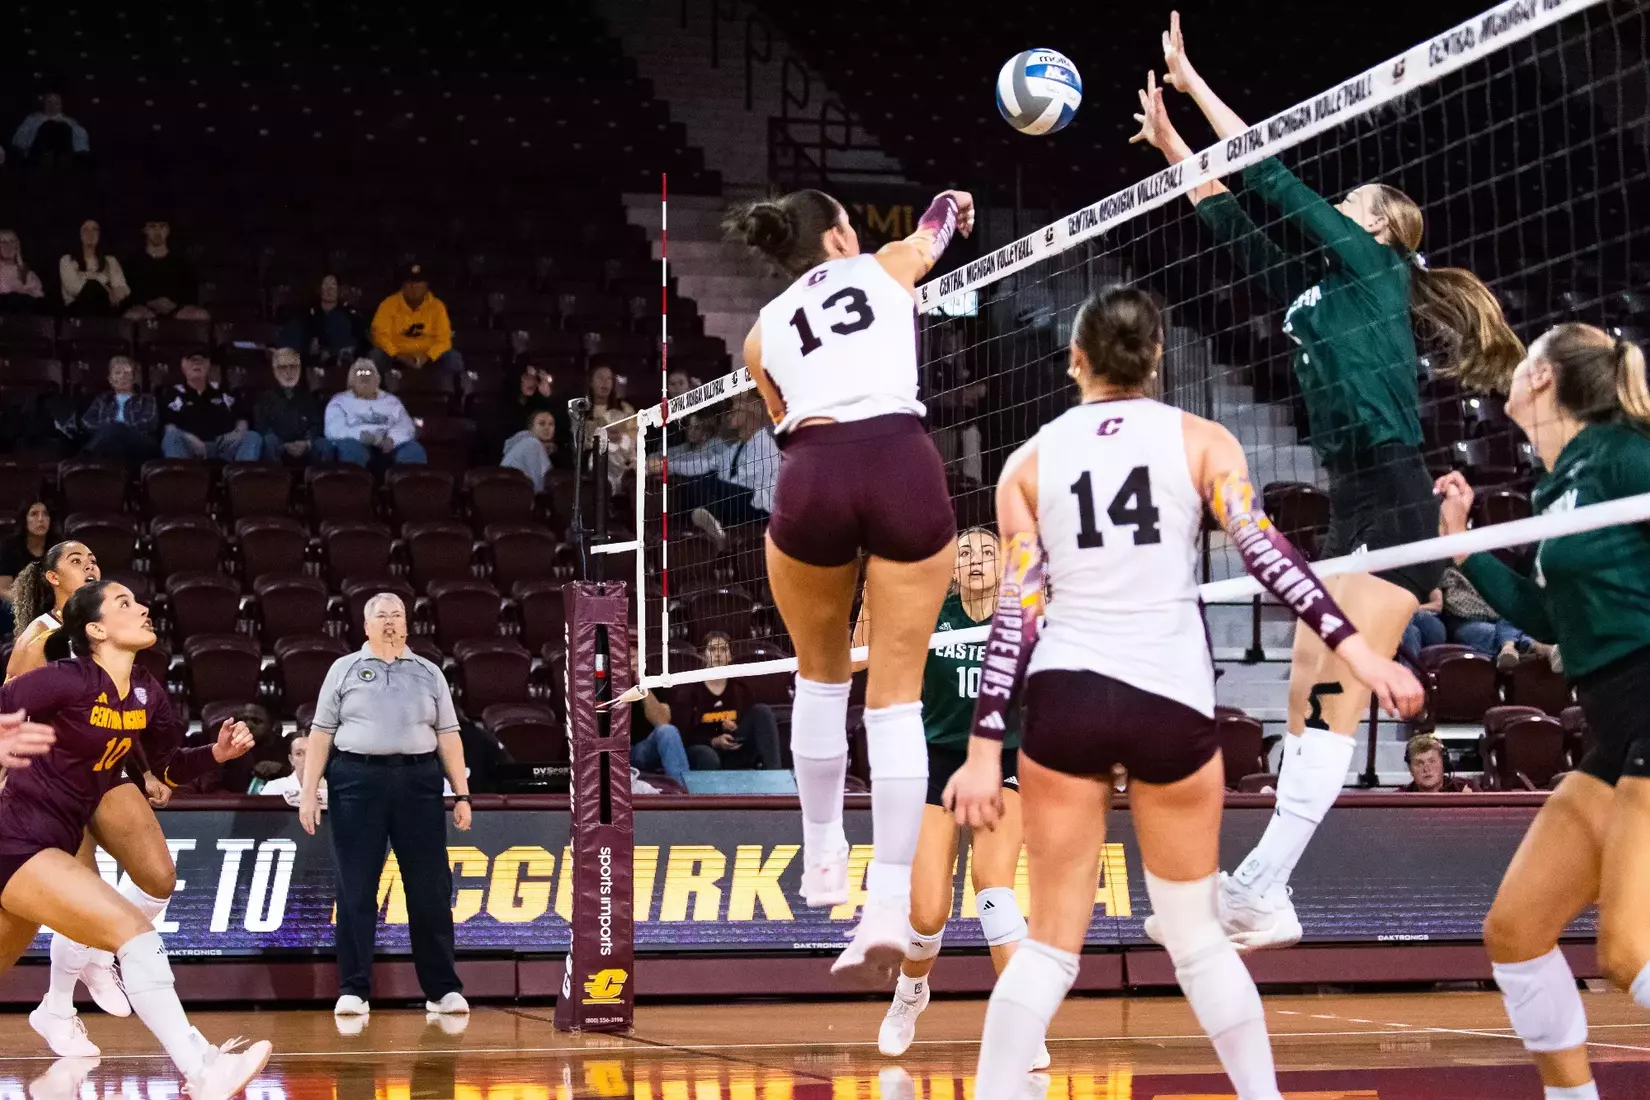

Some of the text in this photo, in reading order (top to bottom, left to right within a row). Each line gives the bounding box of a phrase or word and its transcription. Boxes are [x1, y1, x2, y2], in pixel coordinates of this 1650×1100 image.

[1067, 209, 1099, 237] CENTRAL
[939, 236, 1034, 297] CENTRAL MICHIGAN VOLLEYBALL
[788, 286, 876, 358] 13
[1096, 417, 1124, 437] C
[1070, 464, 1162, 550] 14
[1228, 512, 1325, 614] CHIPPEWAS
[981, 582, 1024, 700] CHIPPEWAS
[956, 665, 982, 699] 10
[92, 737, 132, 772] 10
[209, 838, 297, 934] TO
[597, 846, 612, 956] sports imports
[1377, 934, 1430, 942] DAKTRONICS
